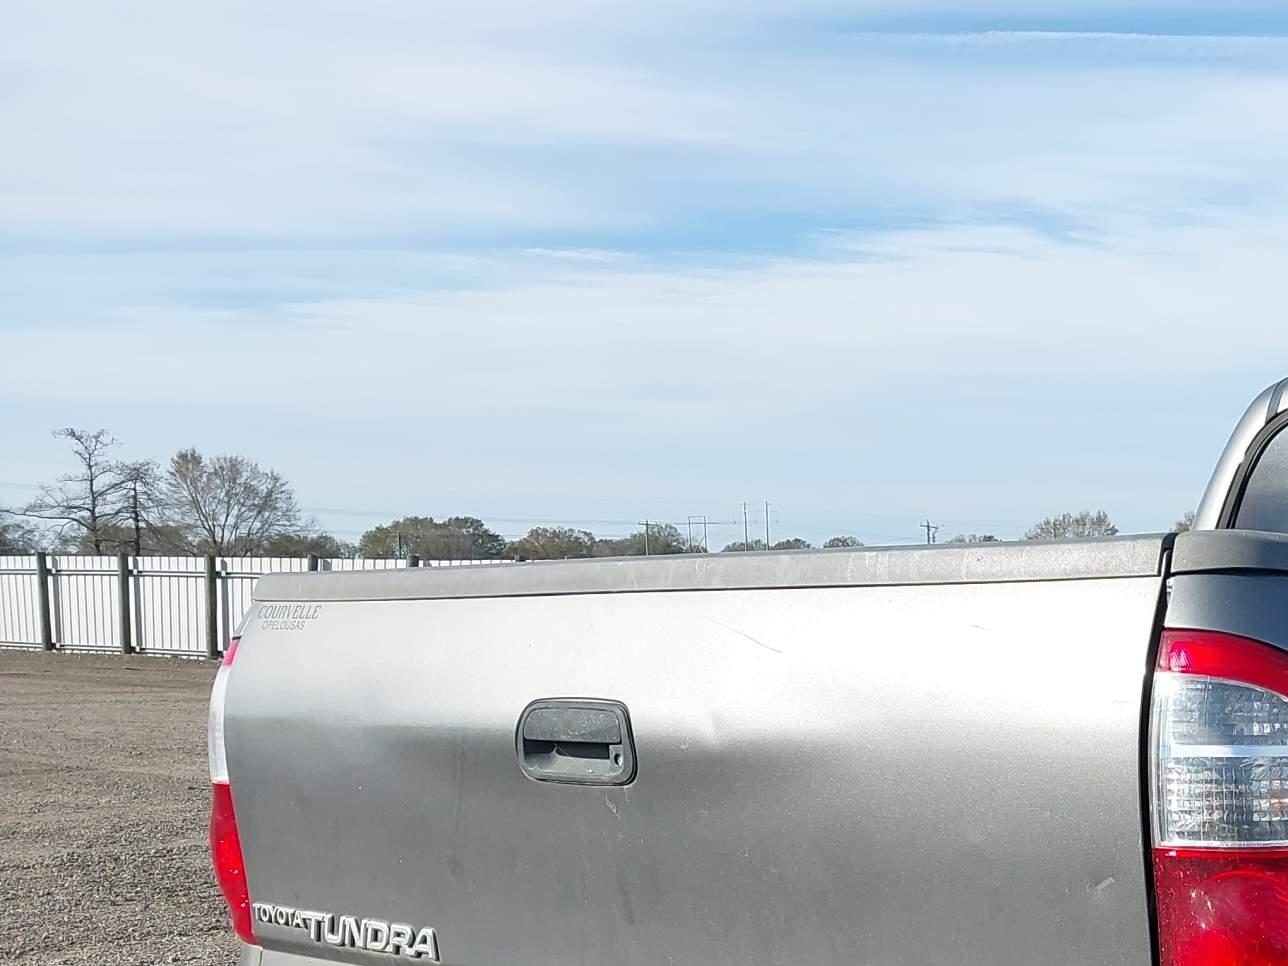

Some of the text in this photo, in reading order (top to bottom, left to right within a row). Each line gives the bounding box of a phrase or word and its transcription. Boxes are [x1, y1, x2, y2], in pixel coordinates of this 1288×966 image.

[257, 605, 322, 619] COURVELLE
[253, 903, 441, 962] TOYOTA TUNDRA
